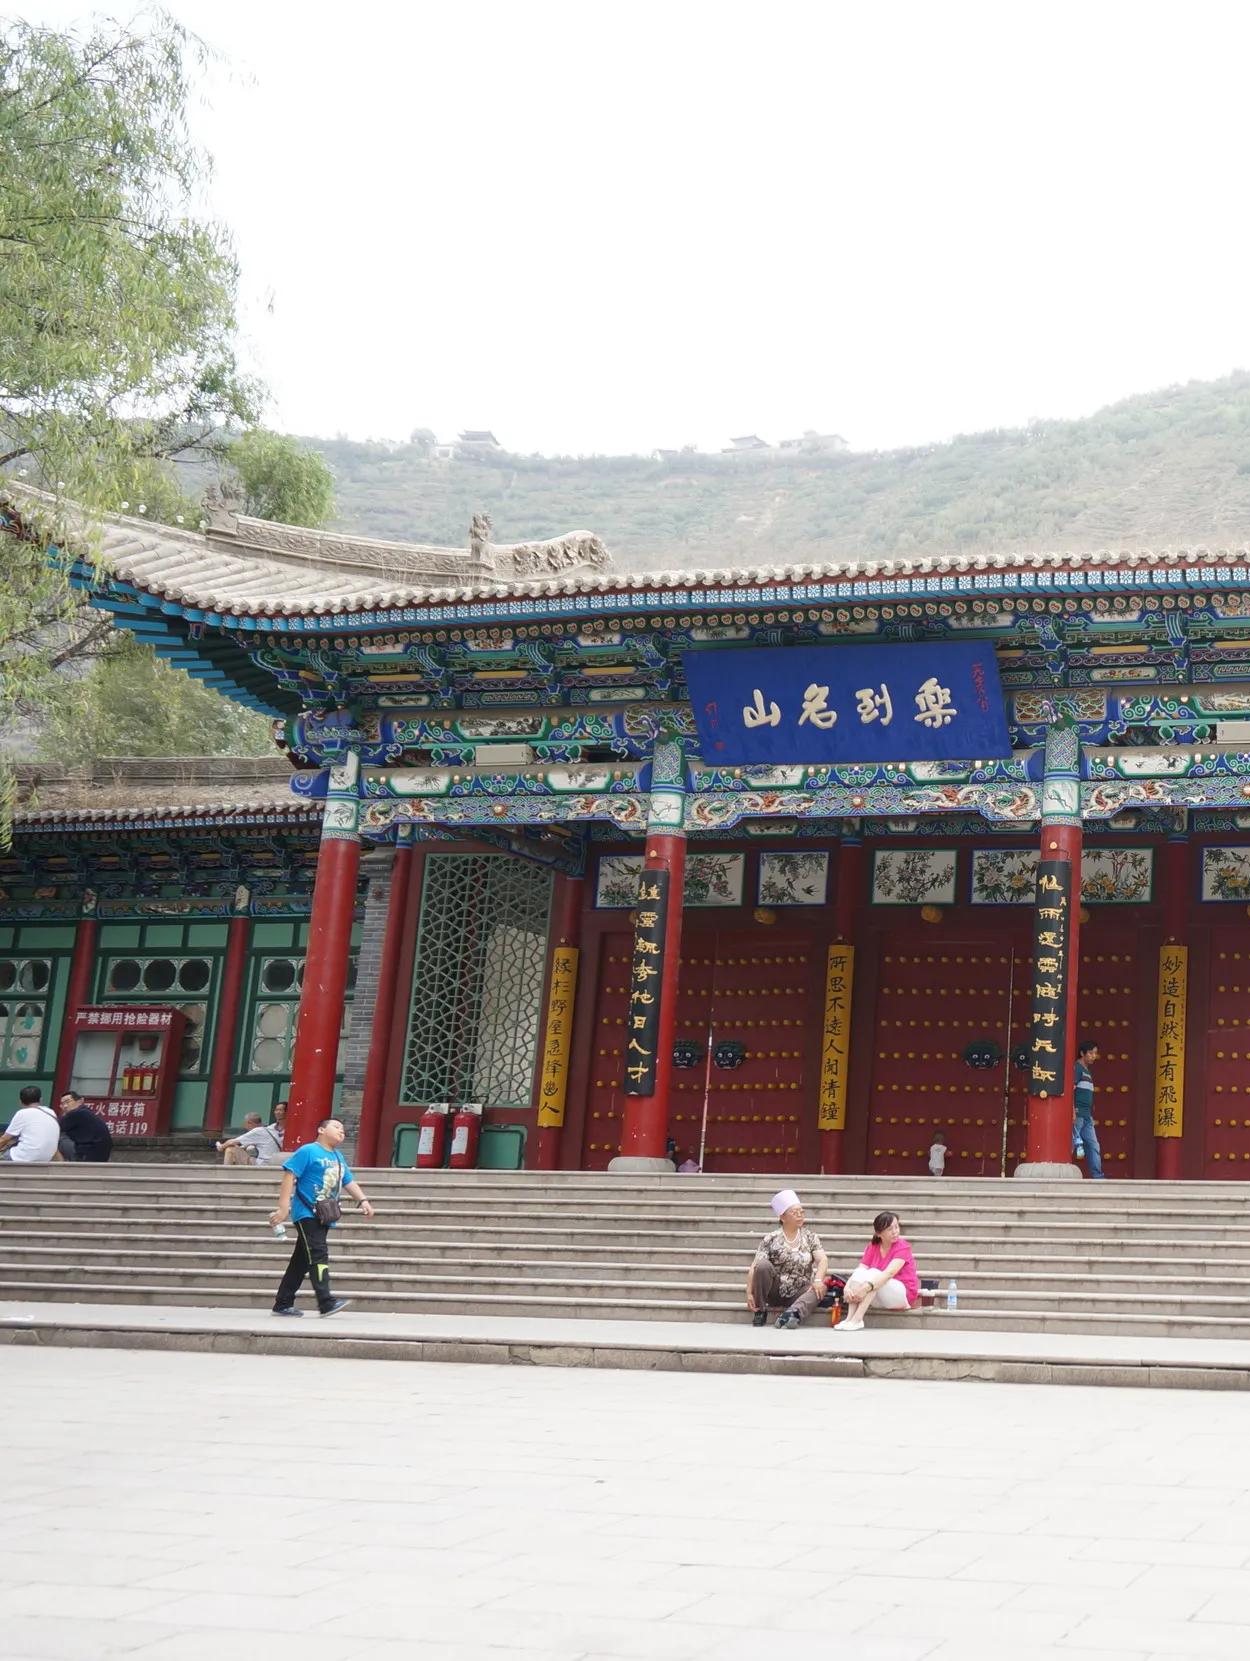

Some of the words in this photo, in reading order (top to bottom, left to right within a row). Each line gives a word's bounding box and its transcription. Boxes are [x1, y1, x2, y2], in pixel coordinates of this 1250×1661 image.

[75, 1012, 172, 1026] 严禁挪用抢险器材
